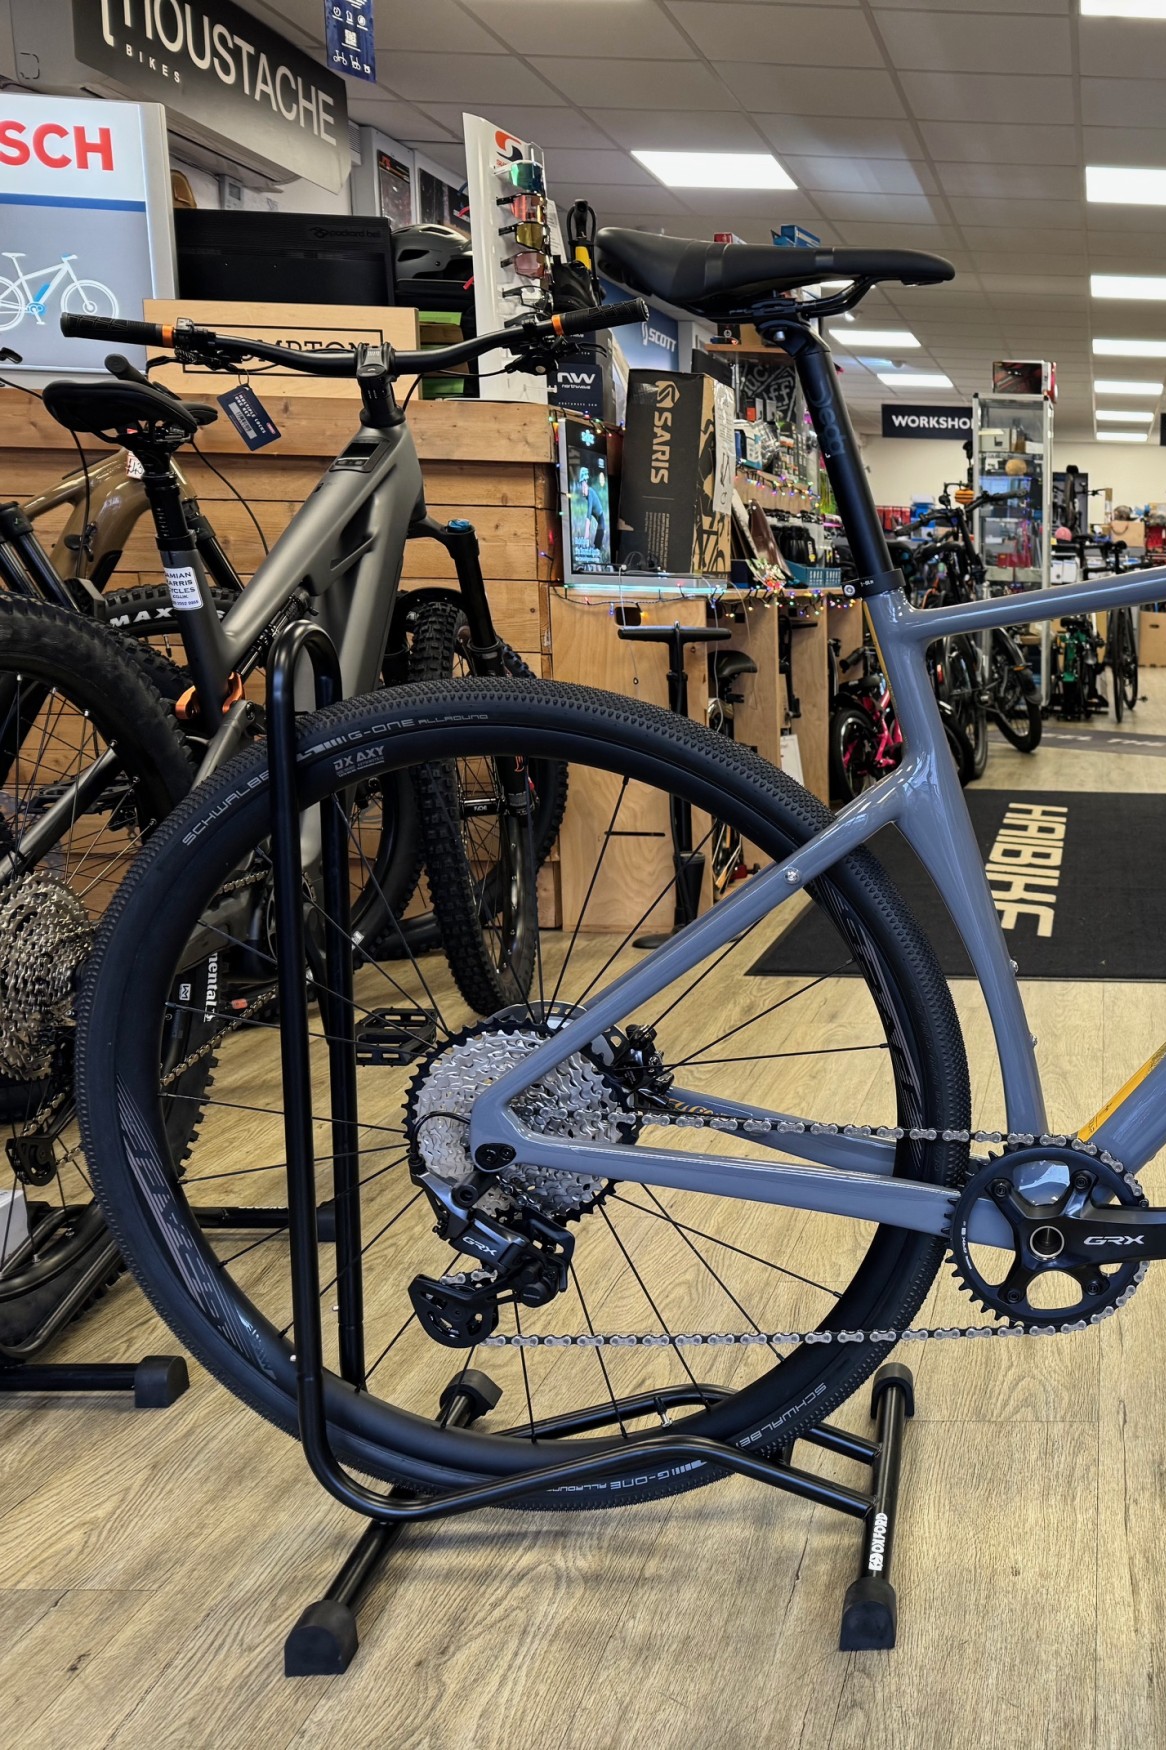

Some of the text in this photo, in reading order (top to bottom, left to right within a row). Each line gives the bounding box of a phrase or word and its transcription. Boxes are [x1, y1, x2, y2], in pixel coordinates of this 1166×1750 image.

[126, 43, 181, 83] BIKES
[0, 120, 114, 171] SCH
[648, 327, 676, 353] SCOTT
[254, 418, 266, 434] LOCKS
[650, 411, 672, 484] SARIS
[109, 607, 226, 627] MAXS
[349, 713, 489, 741] G-ONE ALLROUND
[356, 745, 385, 762] AXY
[182, 769, 269, 847] SCHWALBE
[462, 1236, 497, 1257] GRX
[1083, 1235, 1145, 1245] GRX
[739, 1383, 827, 1448] SCHWALBE
[547, 1469, 671, 1492] G-ONE ALLROUN
[871, 1513, 888, 1554] OXFORD
